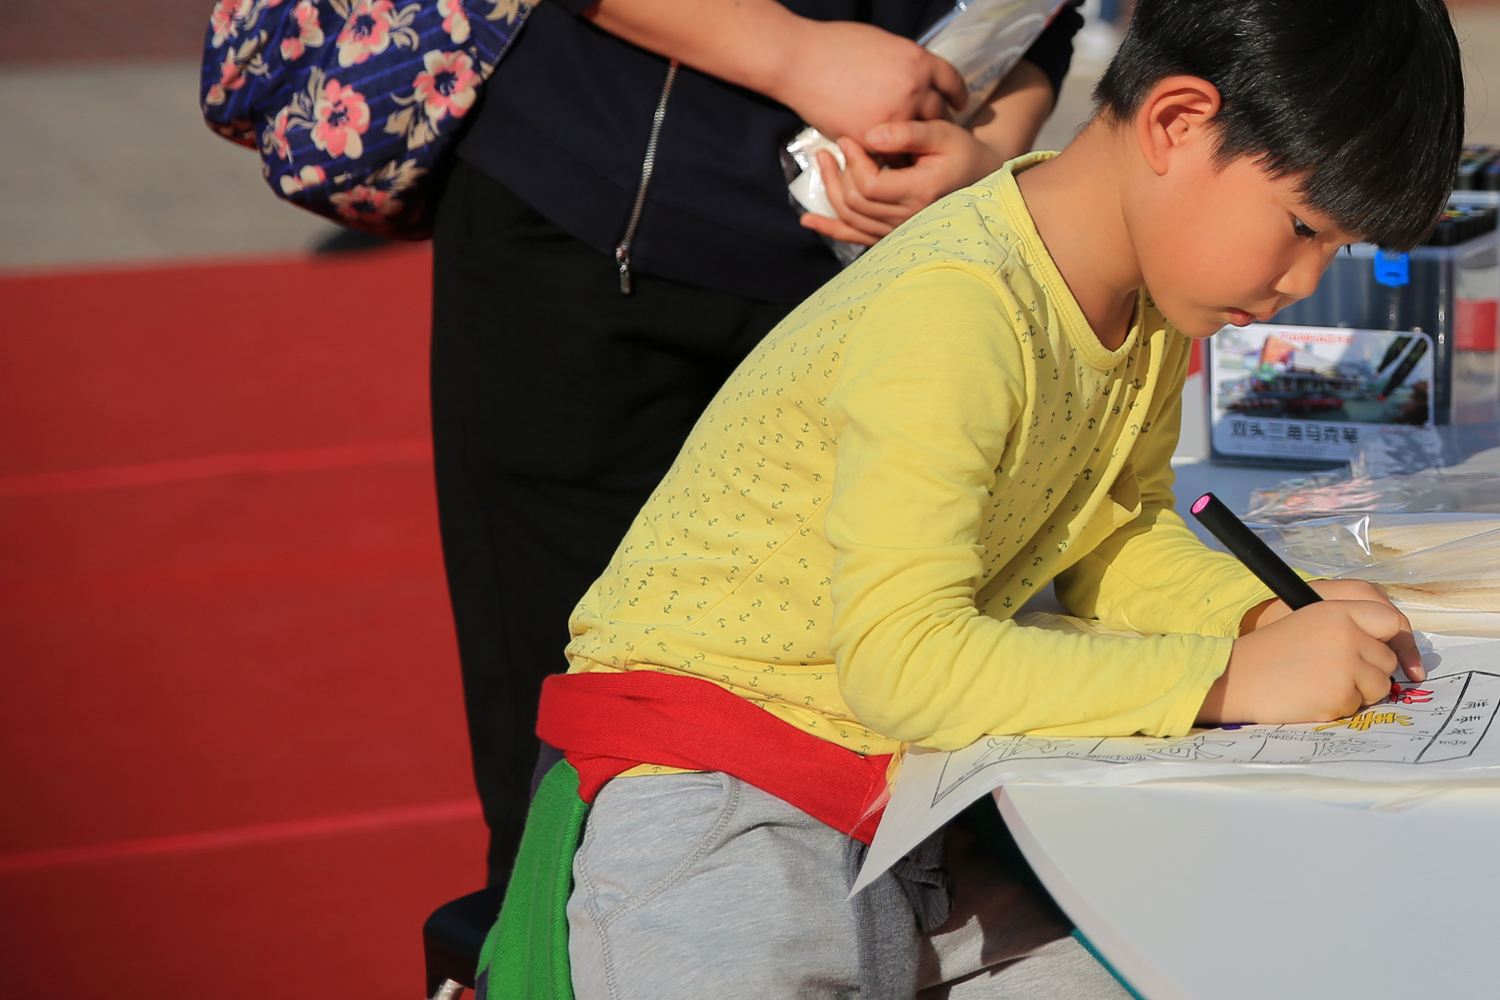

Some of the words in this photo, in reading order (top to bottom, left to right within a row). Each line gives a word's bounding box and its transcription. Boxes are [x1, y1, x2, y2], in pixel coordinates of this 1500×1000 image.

[1230, 419, 1359, 444] 双头三角马克笔
